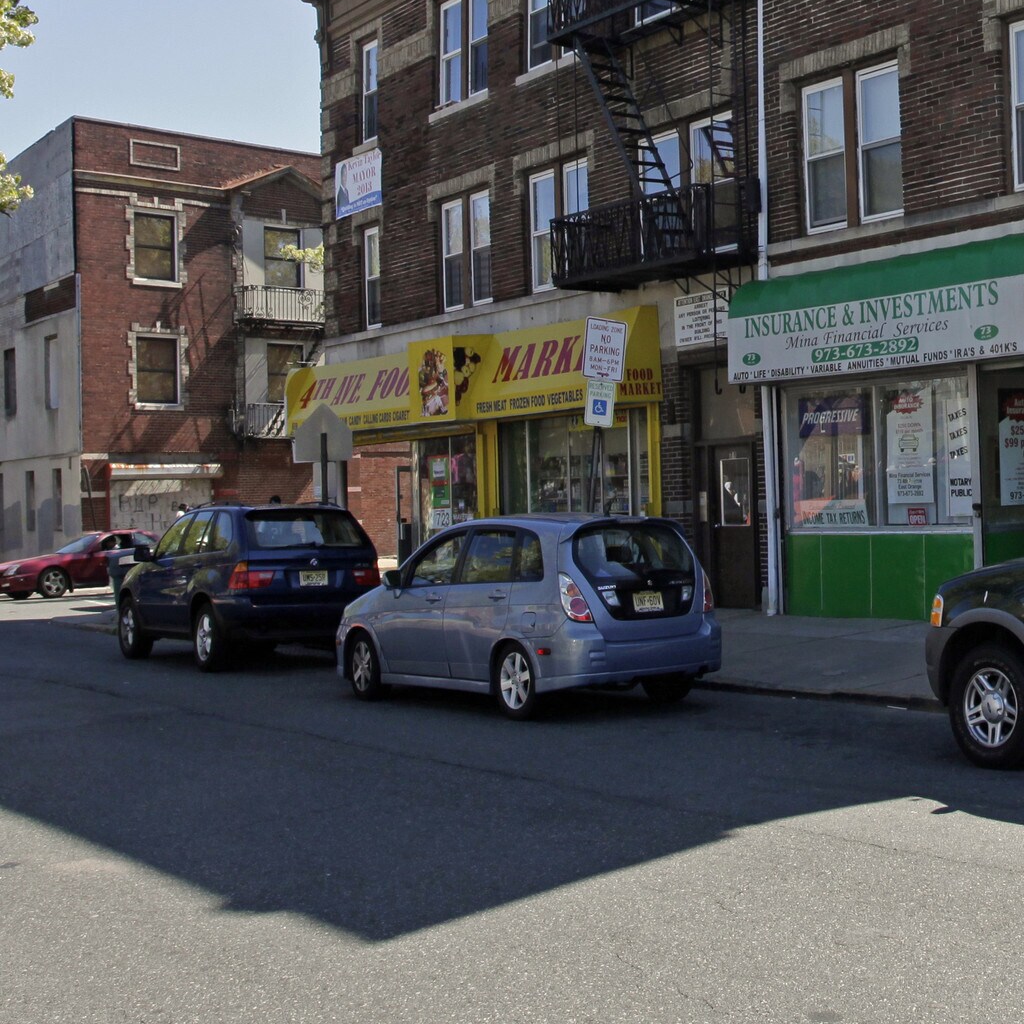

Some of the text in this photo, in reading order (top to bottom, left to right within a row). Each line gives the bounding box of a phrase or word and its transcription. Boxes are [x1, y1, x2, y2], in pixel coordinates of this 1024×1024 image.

[353, 171, 376, 183] MAYOR
[357, 181, 372, 196] 2013
[744, 280, 999, 338] INSURANCE & INVESTMENTS
[590, 323, 623, 334] LOADING ZONE
[785, 318, 949, 350] Mina Financial Services
[983, 326, 992, 334] 73
[600, 335, 611, 344] NO
[590, 344, 620, 356] PARKING
[815, 337, 917, 362] 973-673-2892
[589, 356, 619, 365] 8AM-6PM
[733, 341, 1018, 381] AUTO LIFE DISABILITY VARIABLE ANNUITIES MUTUAL FUNDS IRA'S & 401K'S
[747, 352, 756, 361] 73
[590, 364, 618, 373] MON-FRI
[626, 368, 653, 381] FOOD
[590, 382, 613, 391] RESERVED
[620, 382, 662, 396] MARKET
[300, 378, 337, 410] 4TH
[590, 391, 611, 399] PARKING
[476, 389, 583, 414] FRESH MEAT FROZEN FOOD VEGETABLES
[349, 415, 361, 425] CANDY
[363, 413, 378, 424] CALLING
[380, 412, 392, 422] CARDS
[802, 409, 859, 424] PROGRESSIVE
[948, 408, 967, 422] TAXES
[949, 427, 968, 440] TAXES
[1004, 437, 1018, 449] $99
[950, 446, 968, 459] TAXES
[950, 478, 972, 486] NOTARY
[951, 488, 972, 497] PUBLIC
[802, 510, 865, 525] INCOME TAX RETURNS
[910, 514, 926, 525] OPEN
